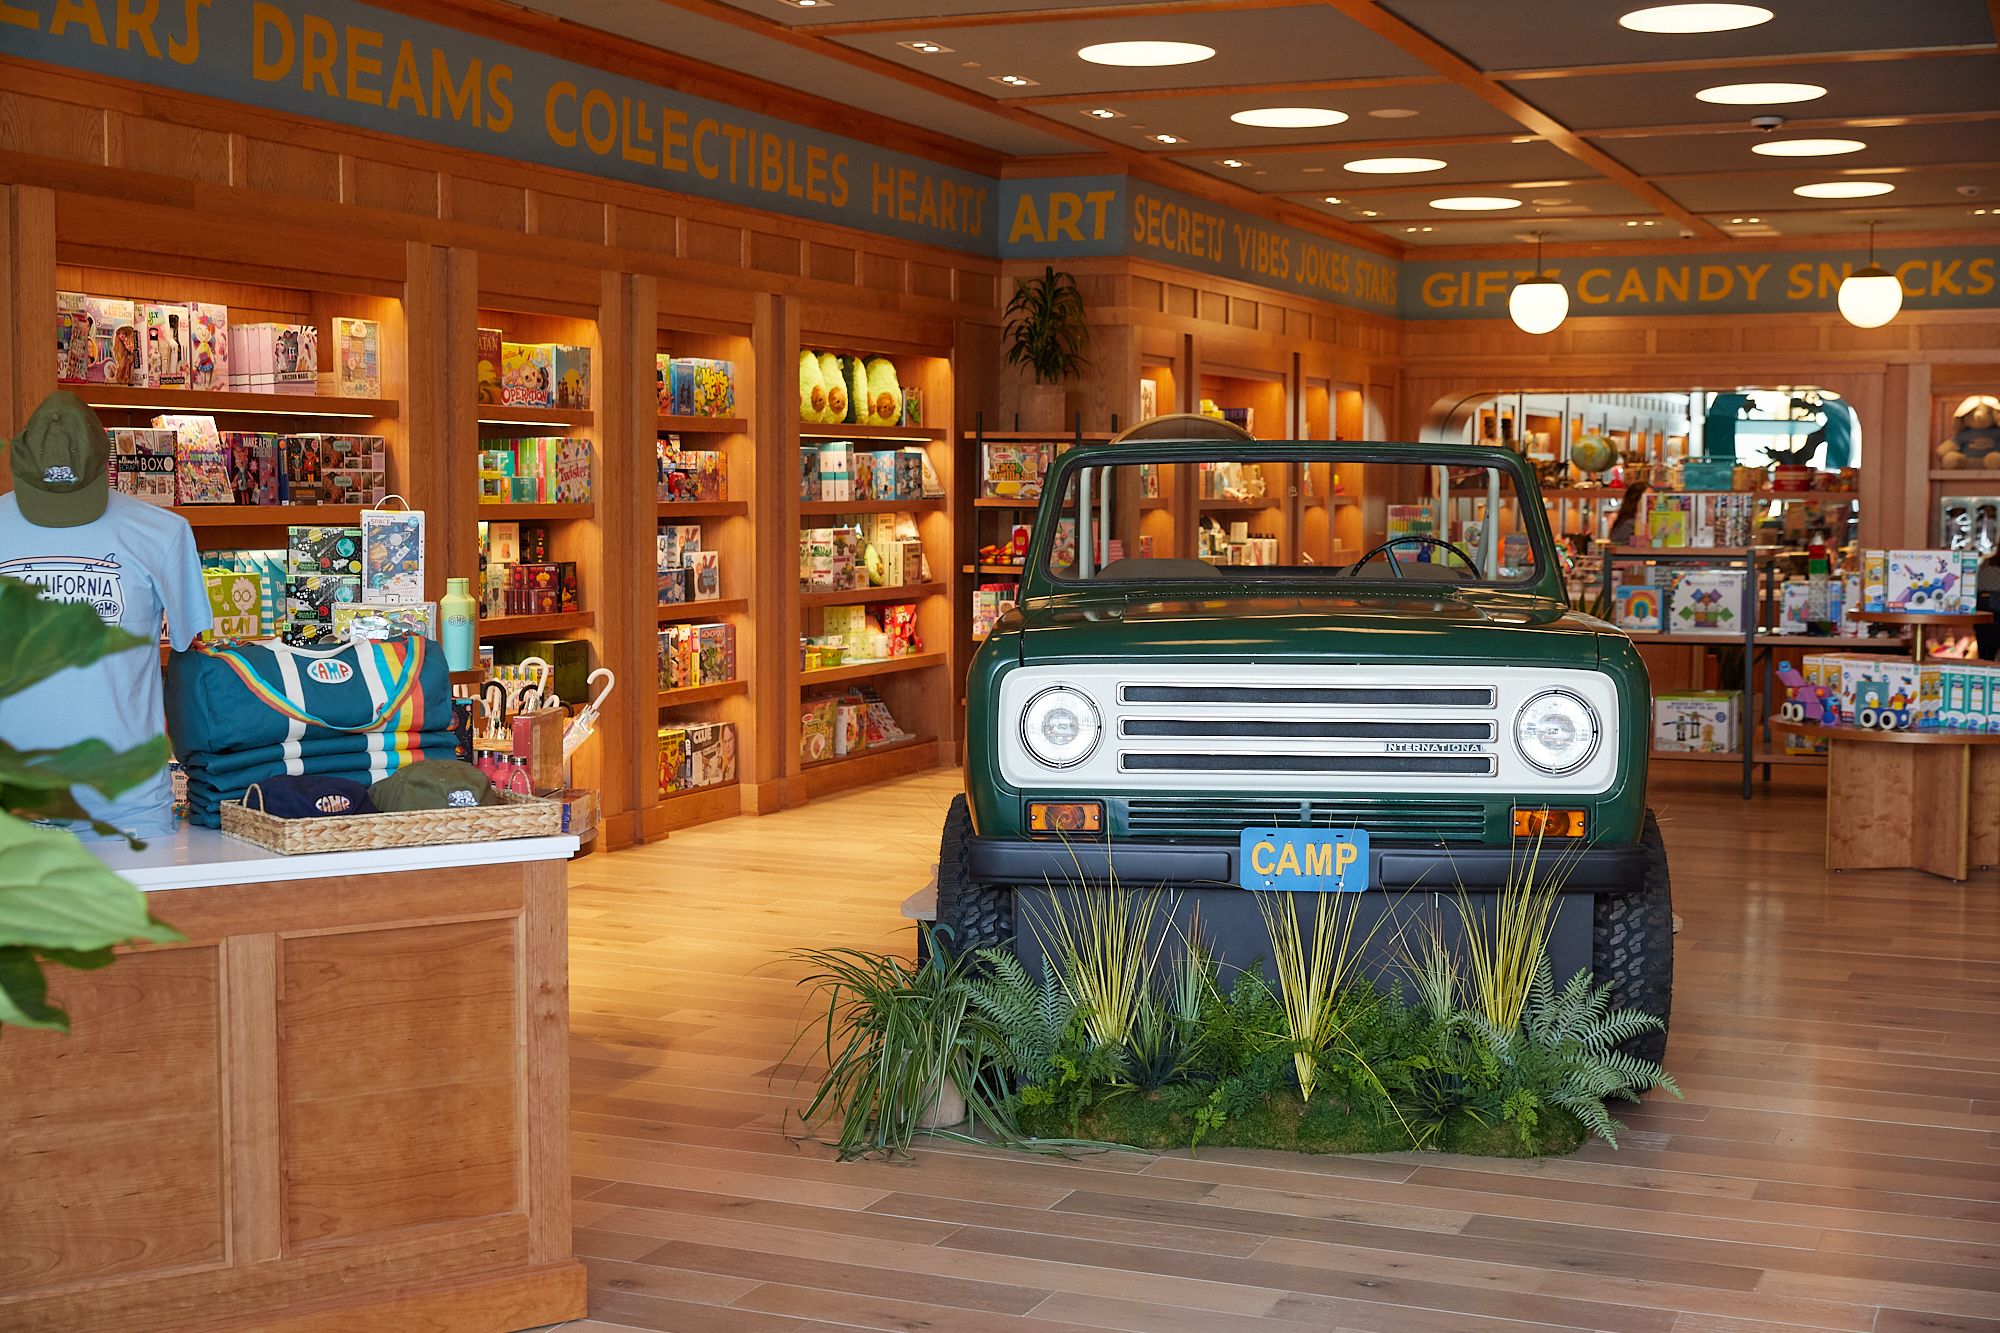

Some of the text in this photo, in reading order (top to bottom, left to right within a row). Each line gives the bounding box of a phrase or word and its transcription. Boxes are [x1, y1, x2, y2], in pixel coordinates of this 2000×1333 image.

[0, 0, 988, 237] ARS DREAMS COLLECTIBLES HEARTS
[1008, 190, 1116, 243] ART
[1133, 193, 1398, 305] SECRETS VIBES JOKES STARS
[1422, 258, 1996, 308] GIF CANDY SNCKS
[478, 336, 498, 352] ATAN
[243, 438, 258, 448] MAKE
[263, 440, 272, 448] FOX
[252, 448, 273, 458] FRIEND
[141, 457, 164, 471] BOX
[559, 464, 587, 482] Twister
[221, 617, 250, 635] CLAY
[311, 662, 349, 680] CAMP
[693, 728, 713, 744] CLUE
[1385, 743, 1487, 752] INTERNATIONAL
[315, 795, 350, 813] CAMP
[1251, 841, 1358, 876] CAMP
